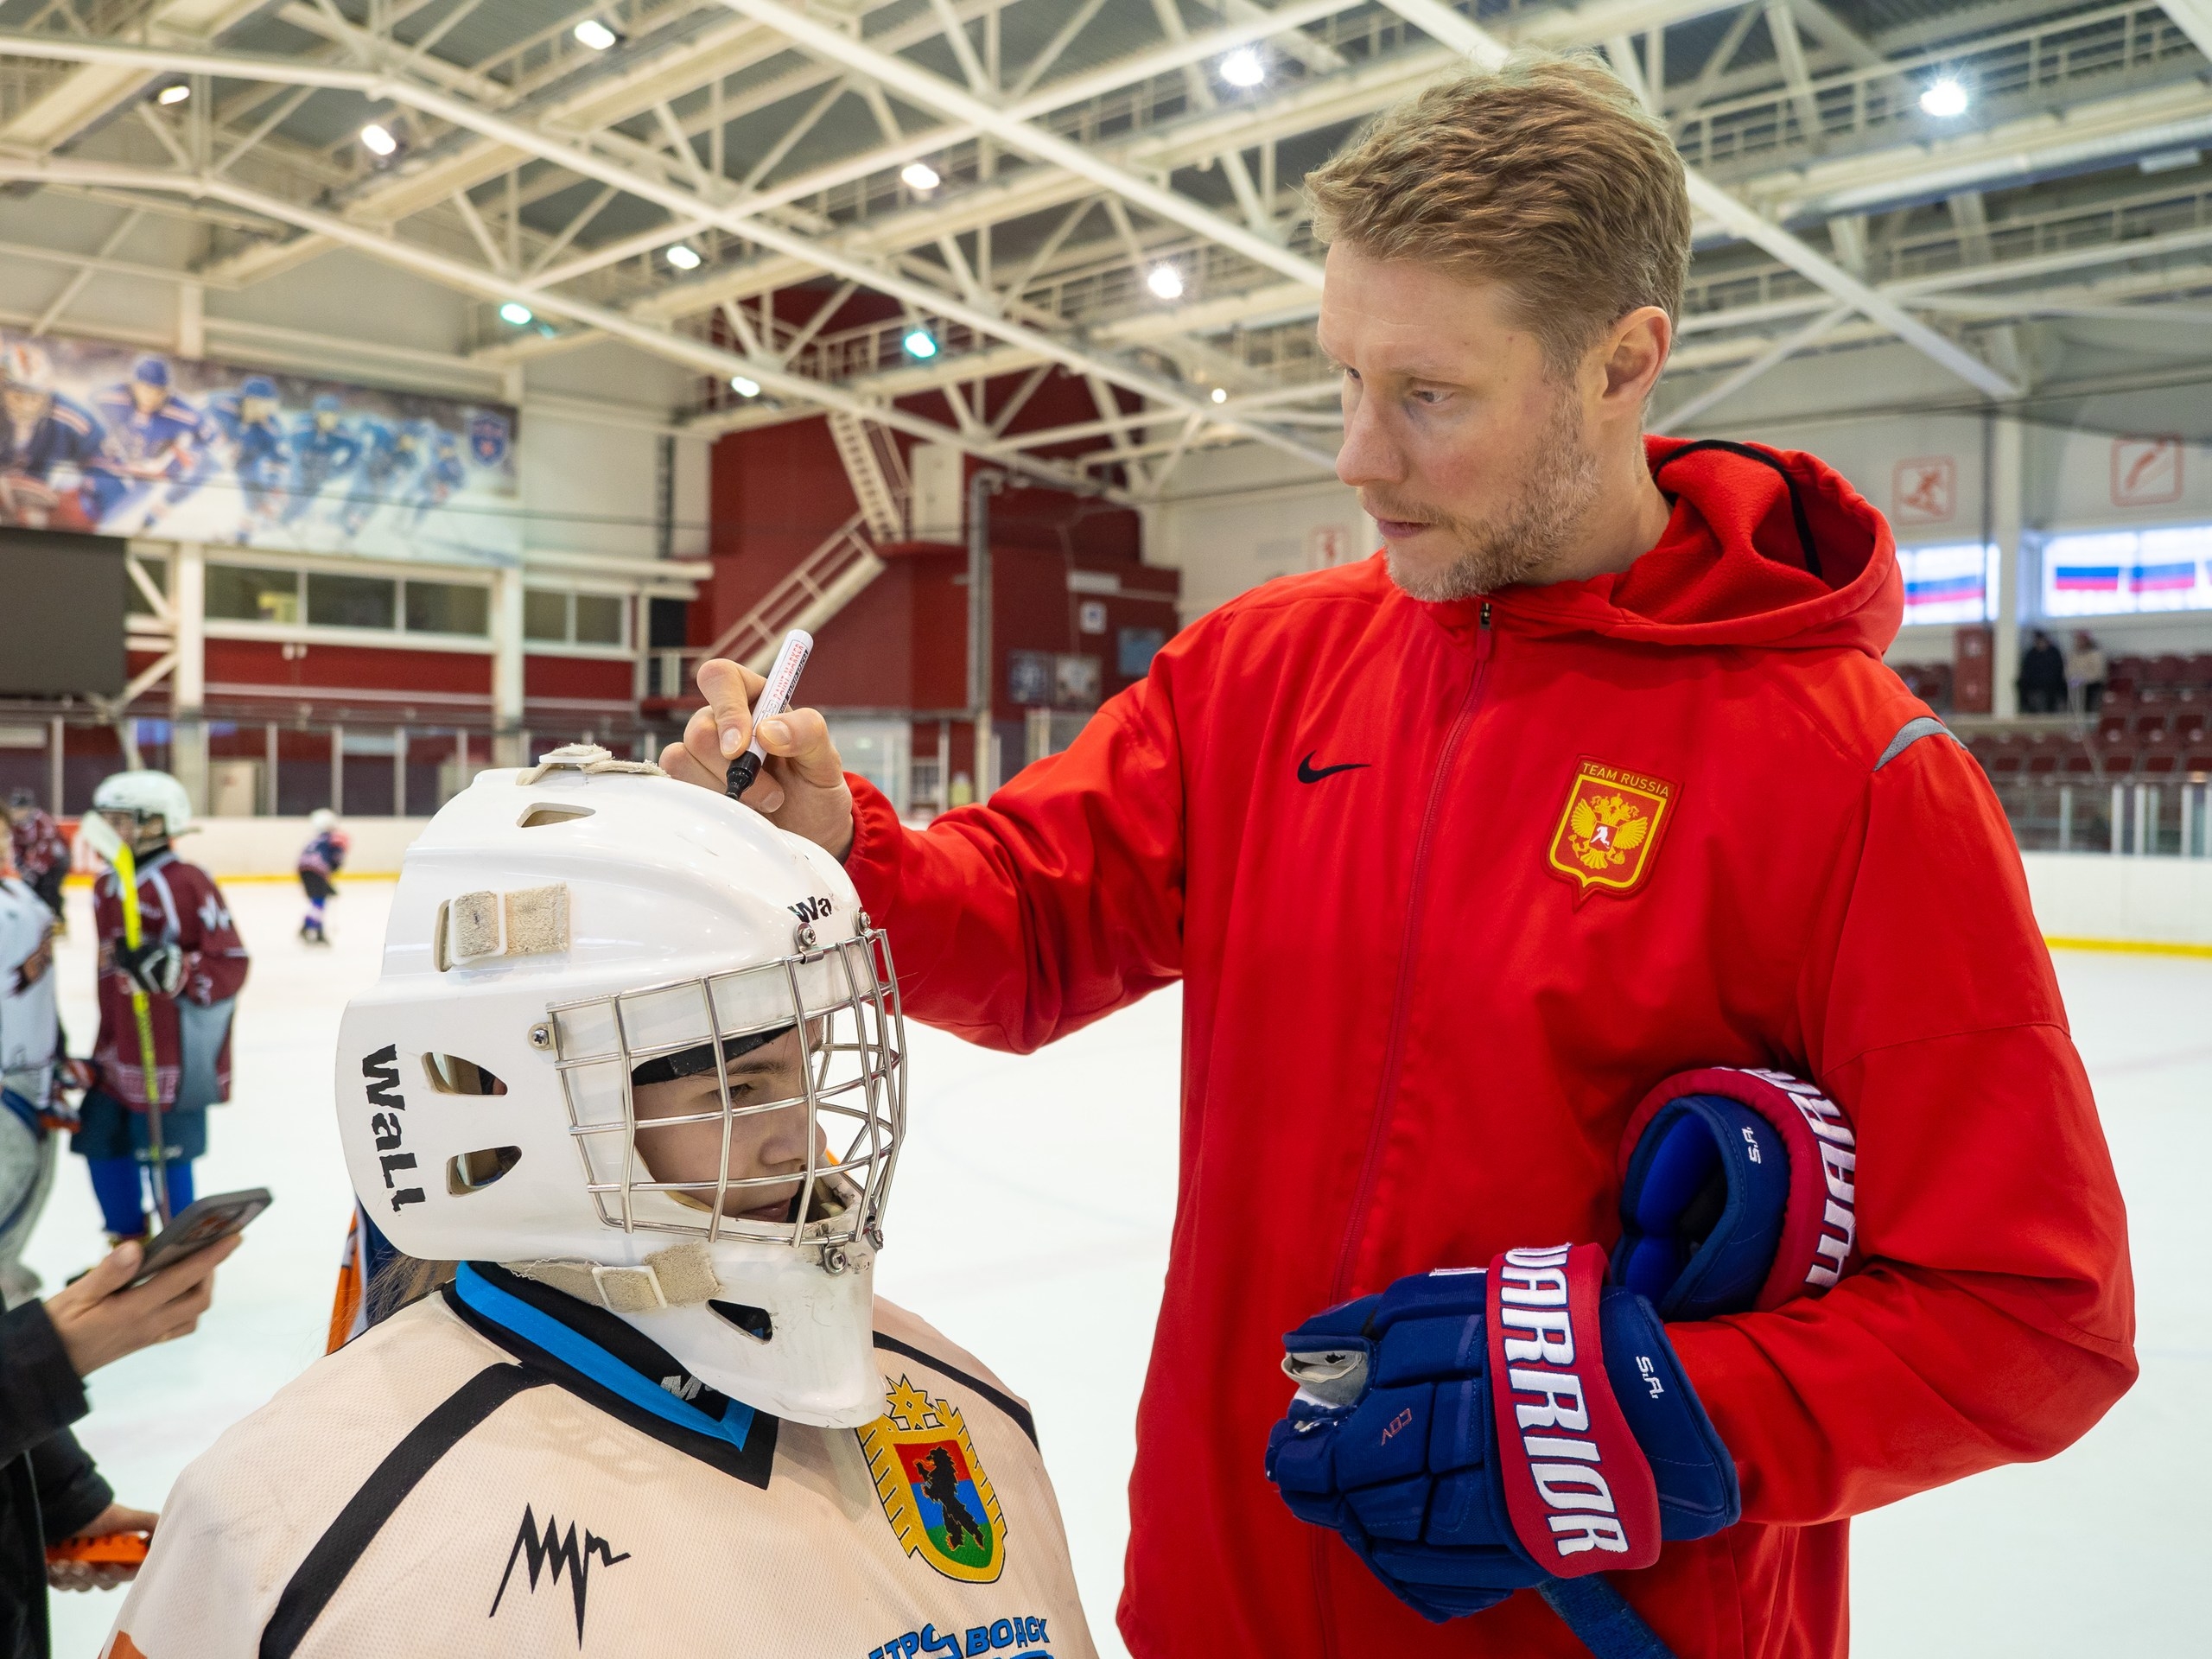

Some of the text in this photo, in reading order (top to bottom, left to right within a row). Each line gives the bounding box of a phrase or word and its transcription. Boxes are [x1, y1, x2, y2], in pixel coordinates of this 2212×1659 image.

[784, 643, 804, 677] MARKER
[1583, 762, 1669, 798] TEAM RUSSIA
[1741, 1126, 1762, 1164] S.A.
[1636, 1356, 1664, 1399] S.A.
